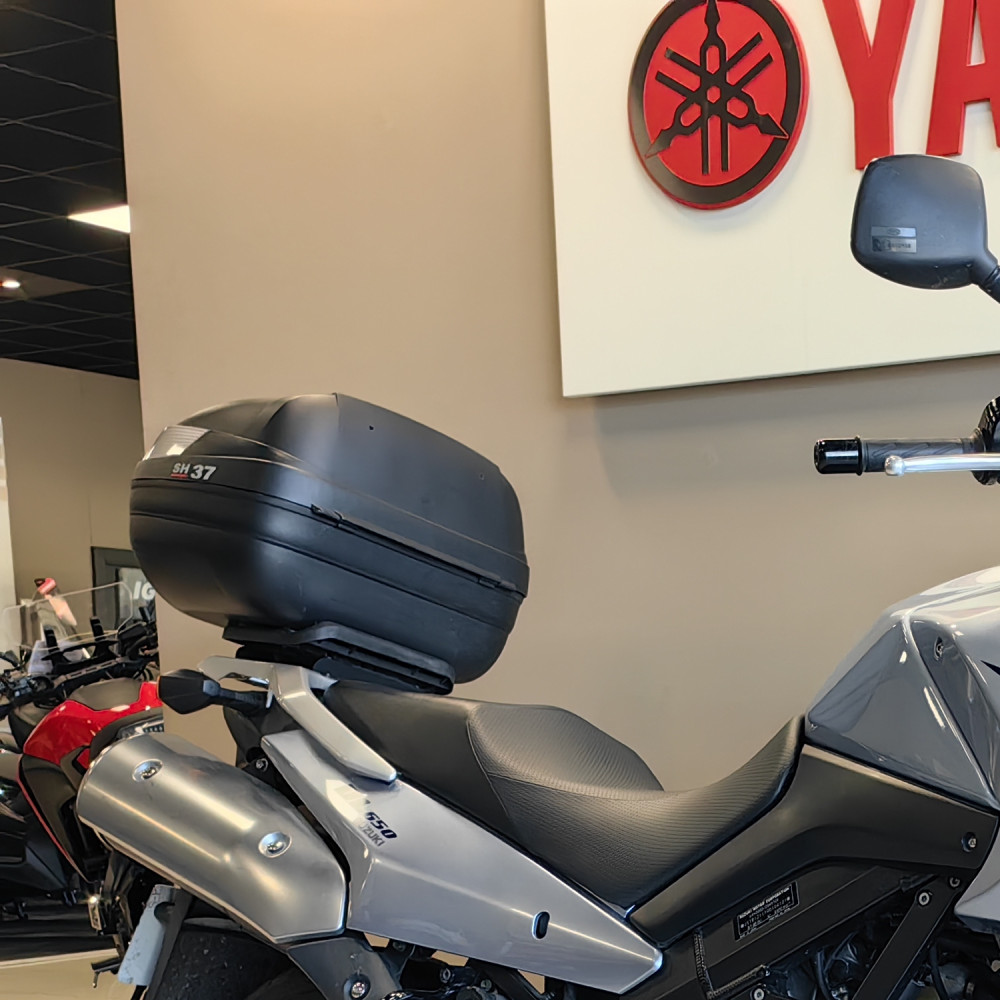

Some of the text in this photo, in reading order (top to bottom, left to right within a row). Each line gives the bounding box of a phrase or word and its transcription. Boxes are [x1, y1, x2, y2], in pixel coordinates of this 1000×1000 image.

[172, 462, 217, 480] SH 37
[365, 811, 398, 839] 650
